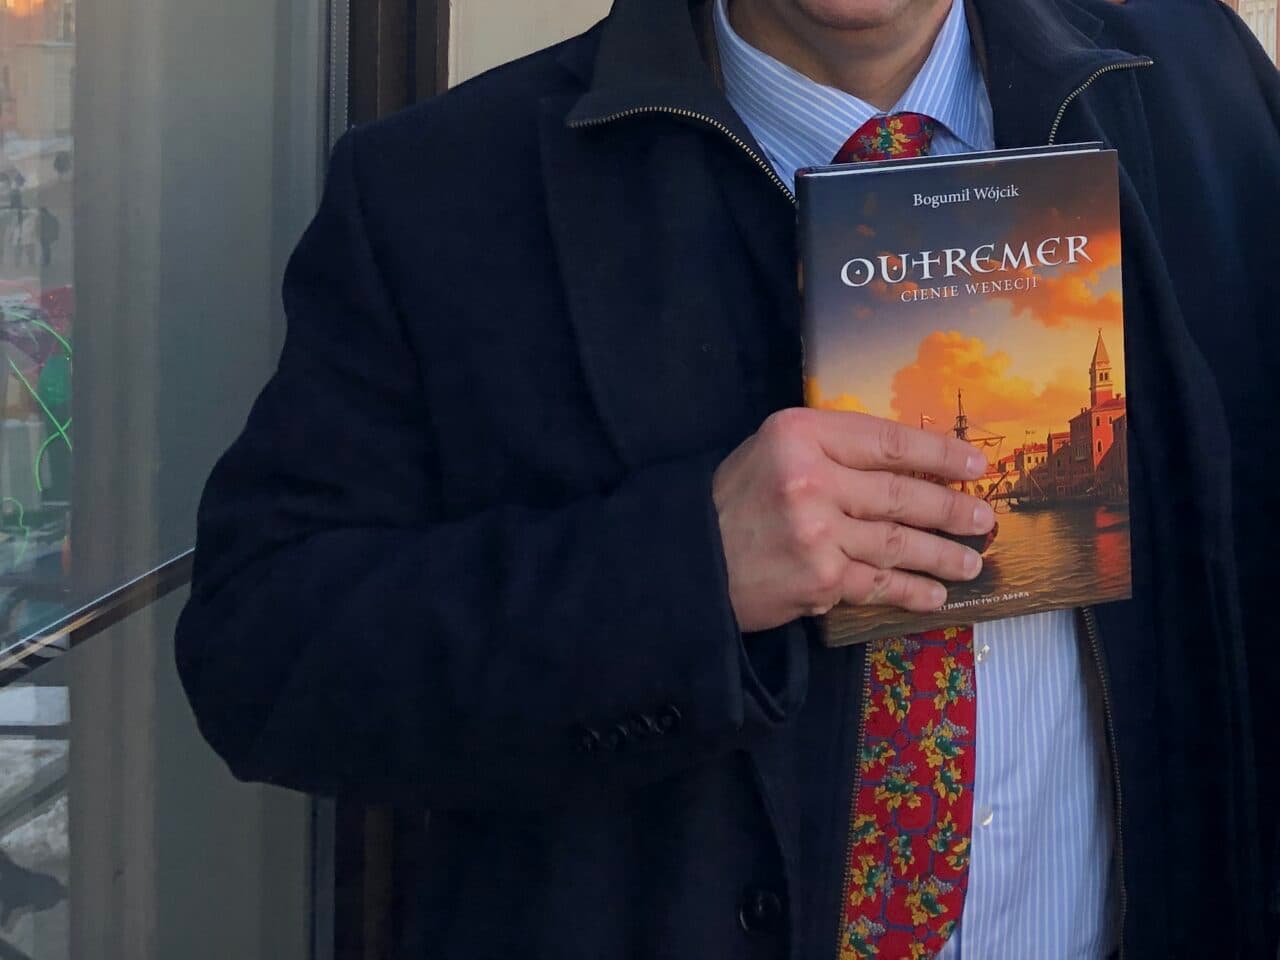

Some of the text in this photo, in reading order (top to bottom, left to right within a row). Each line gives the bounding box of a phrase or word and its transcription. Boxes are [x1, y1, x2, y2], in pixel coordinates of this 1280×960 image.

[973, 184, 1020, 202] Wójcik
[840, 235, 1093, 287] OUTREMER
[900, 276, 1038, 302] CIENIE WENECJI
